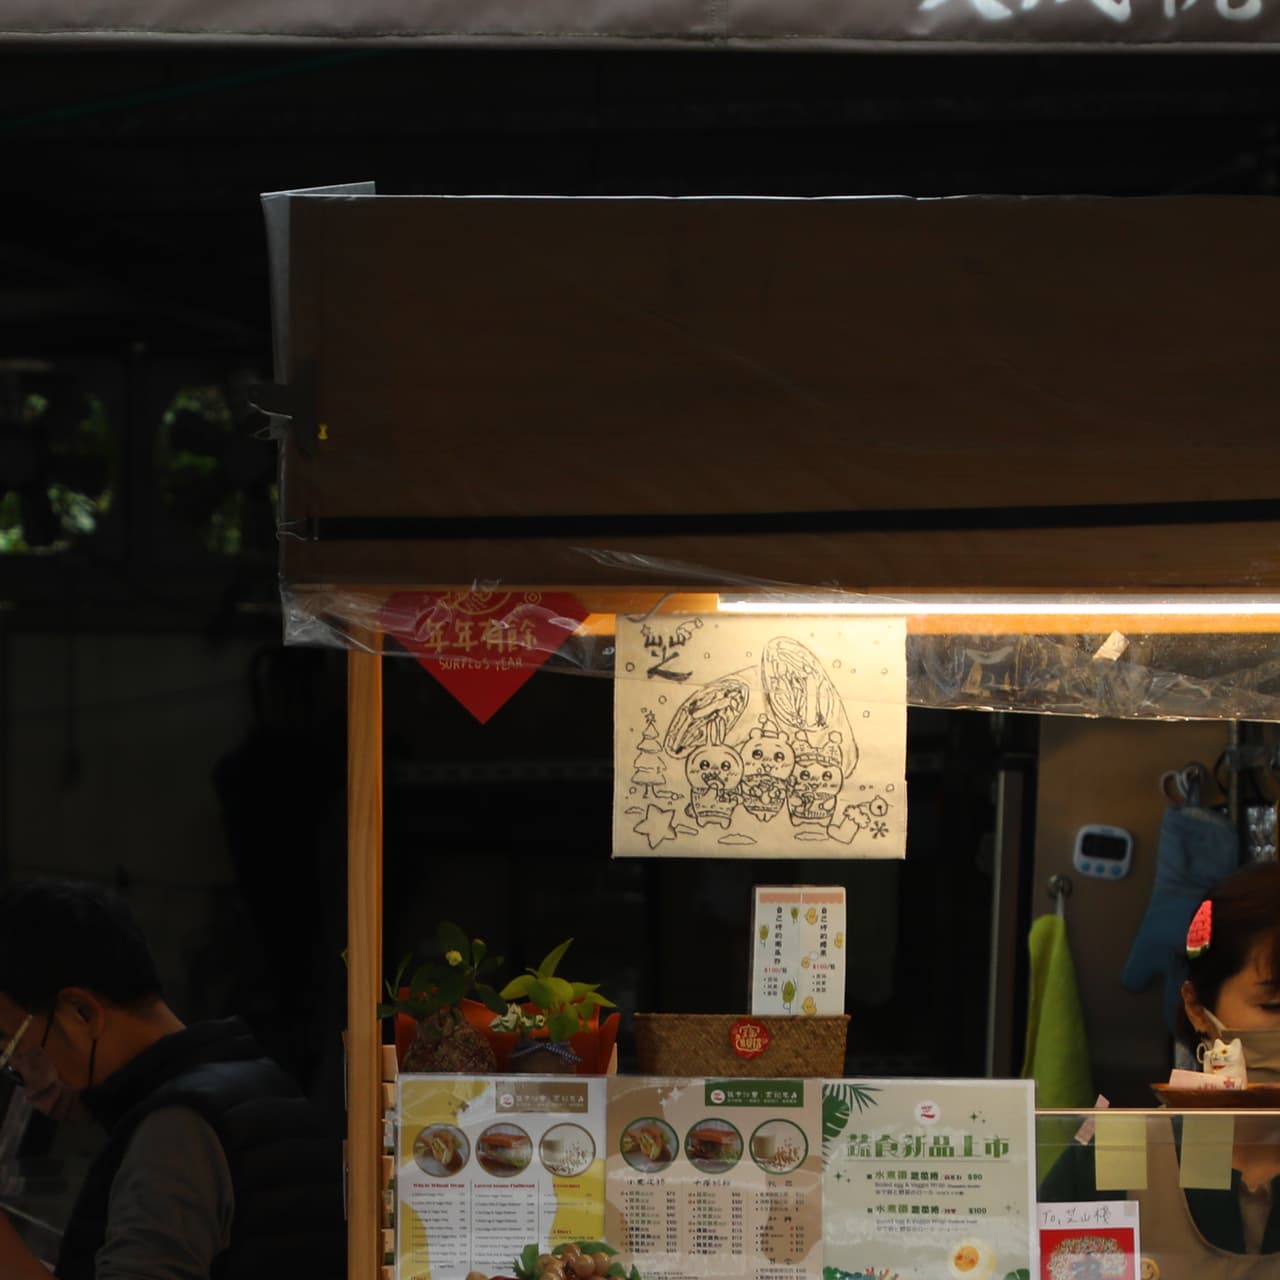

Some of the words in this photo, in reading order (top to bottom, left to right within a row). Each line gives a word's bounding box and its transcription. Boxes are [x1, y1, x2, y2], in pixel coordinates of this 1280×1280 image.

[424, 619, 538, 653] 年年有餘
[847, 1134, 1010, 1158] 蔬食新品上市
